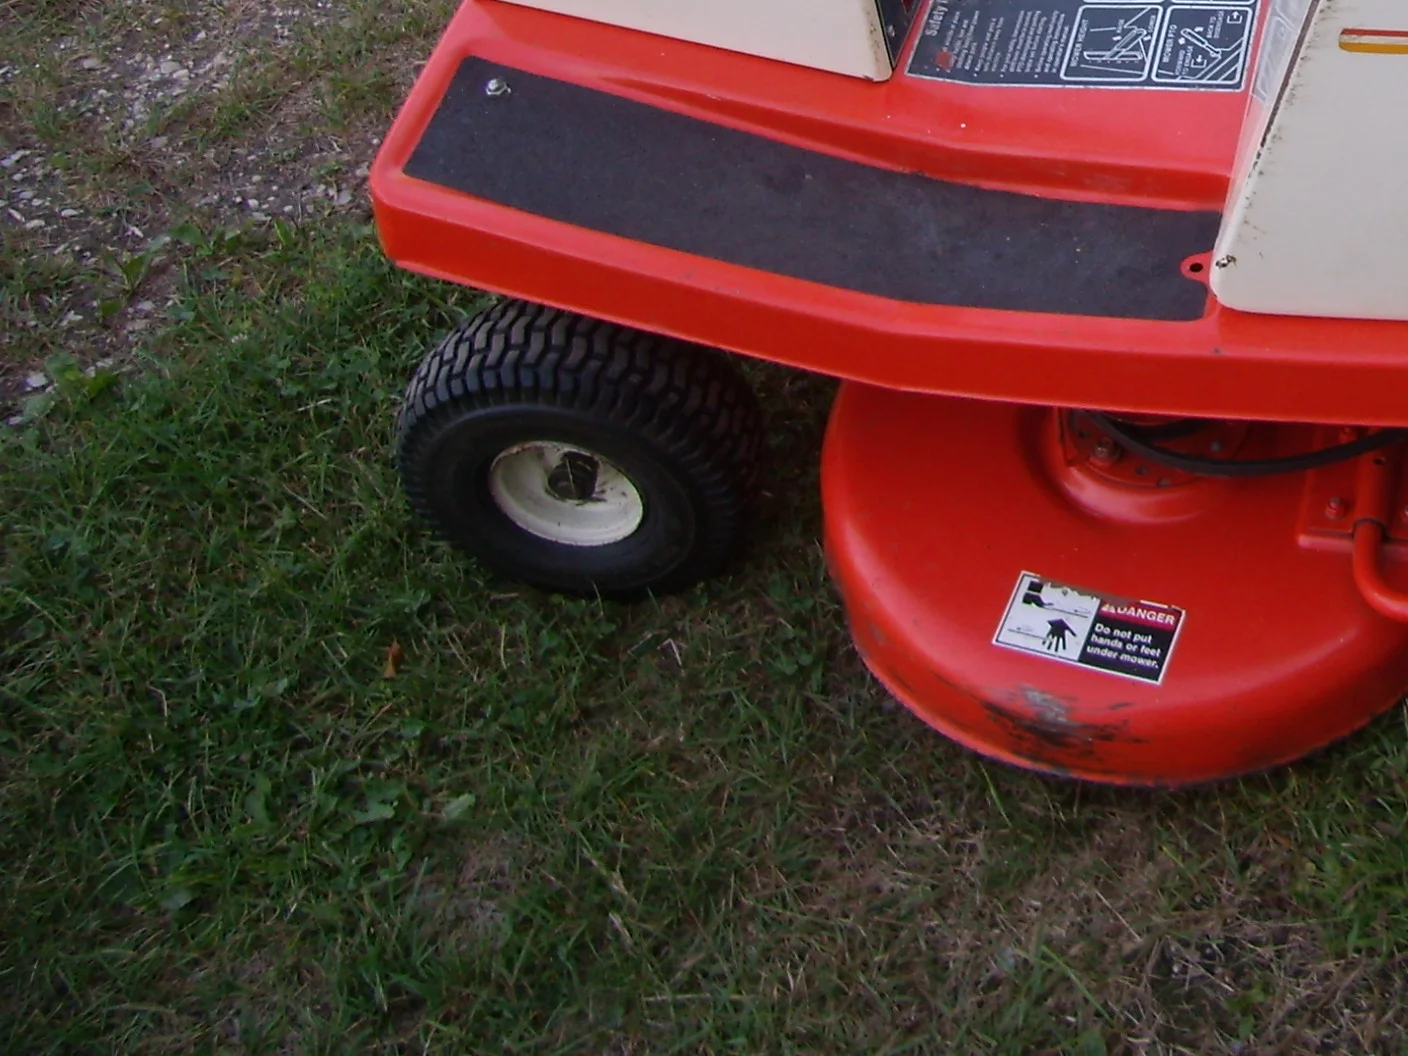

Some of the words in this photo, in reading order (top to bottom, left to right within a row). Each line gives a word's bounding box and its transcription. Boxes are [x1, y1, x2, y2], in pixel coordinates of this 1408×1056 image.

[924, 5, 948, 35] Safety
[1117, 607, 1175, 625] DANGER
[1095, 623, 1110, 634] Do
[1113, 630, 1131, 639] not
[1132, 633, 1152, 644] put
[1091, 634, 1123, 648] hands
[1126, 643, 1138, 652] or
[1141, 644, 1161, 657] feet
[1086, 646, 1117, 659] under
[1120, 653, 1159, 669] mower.
